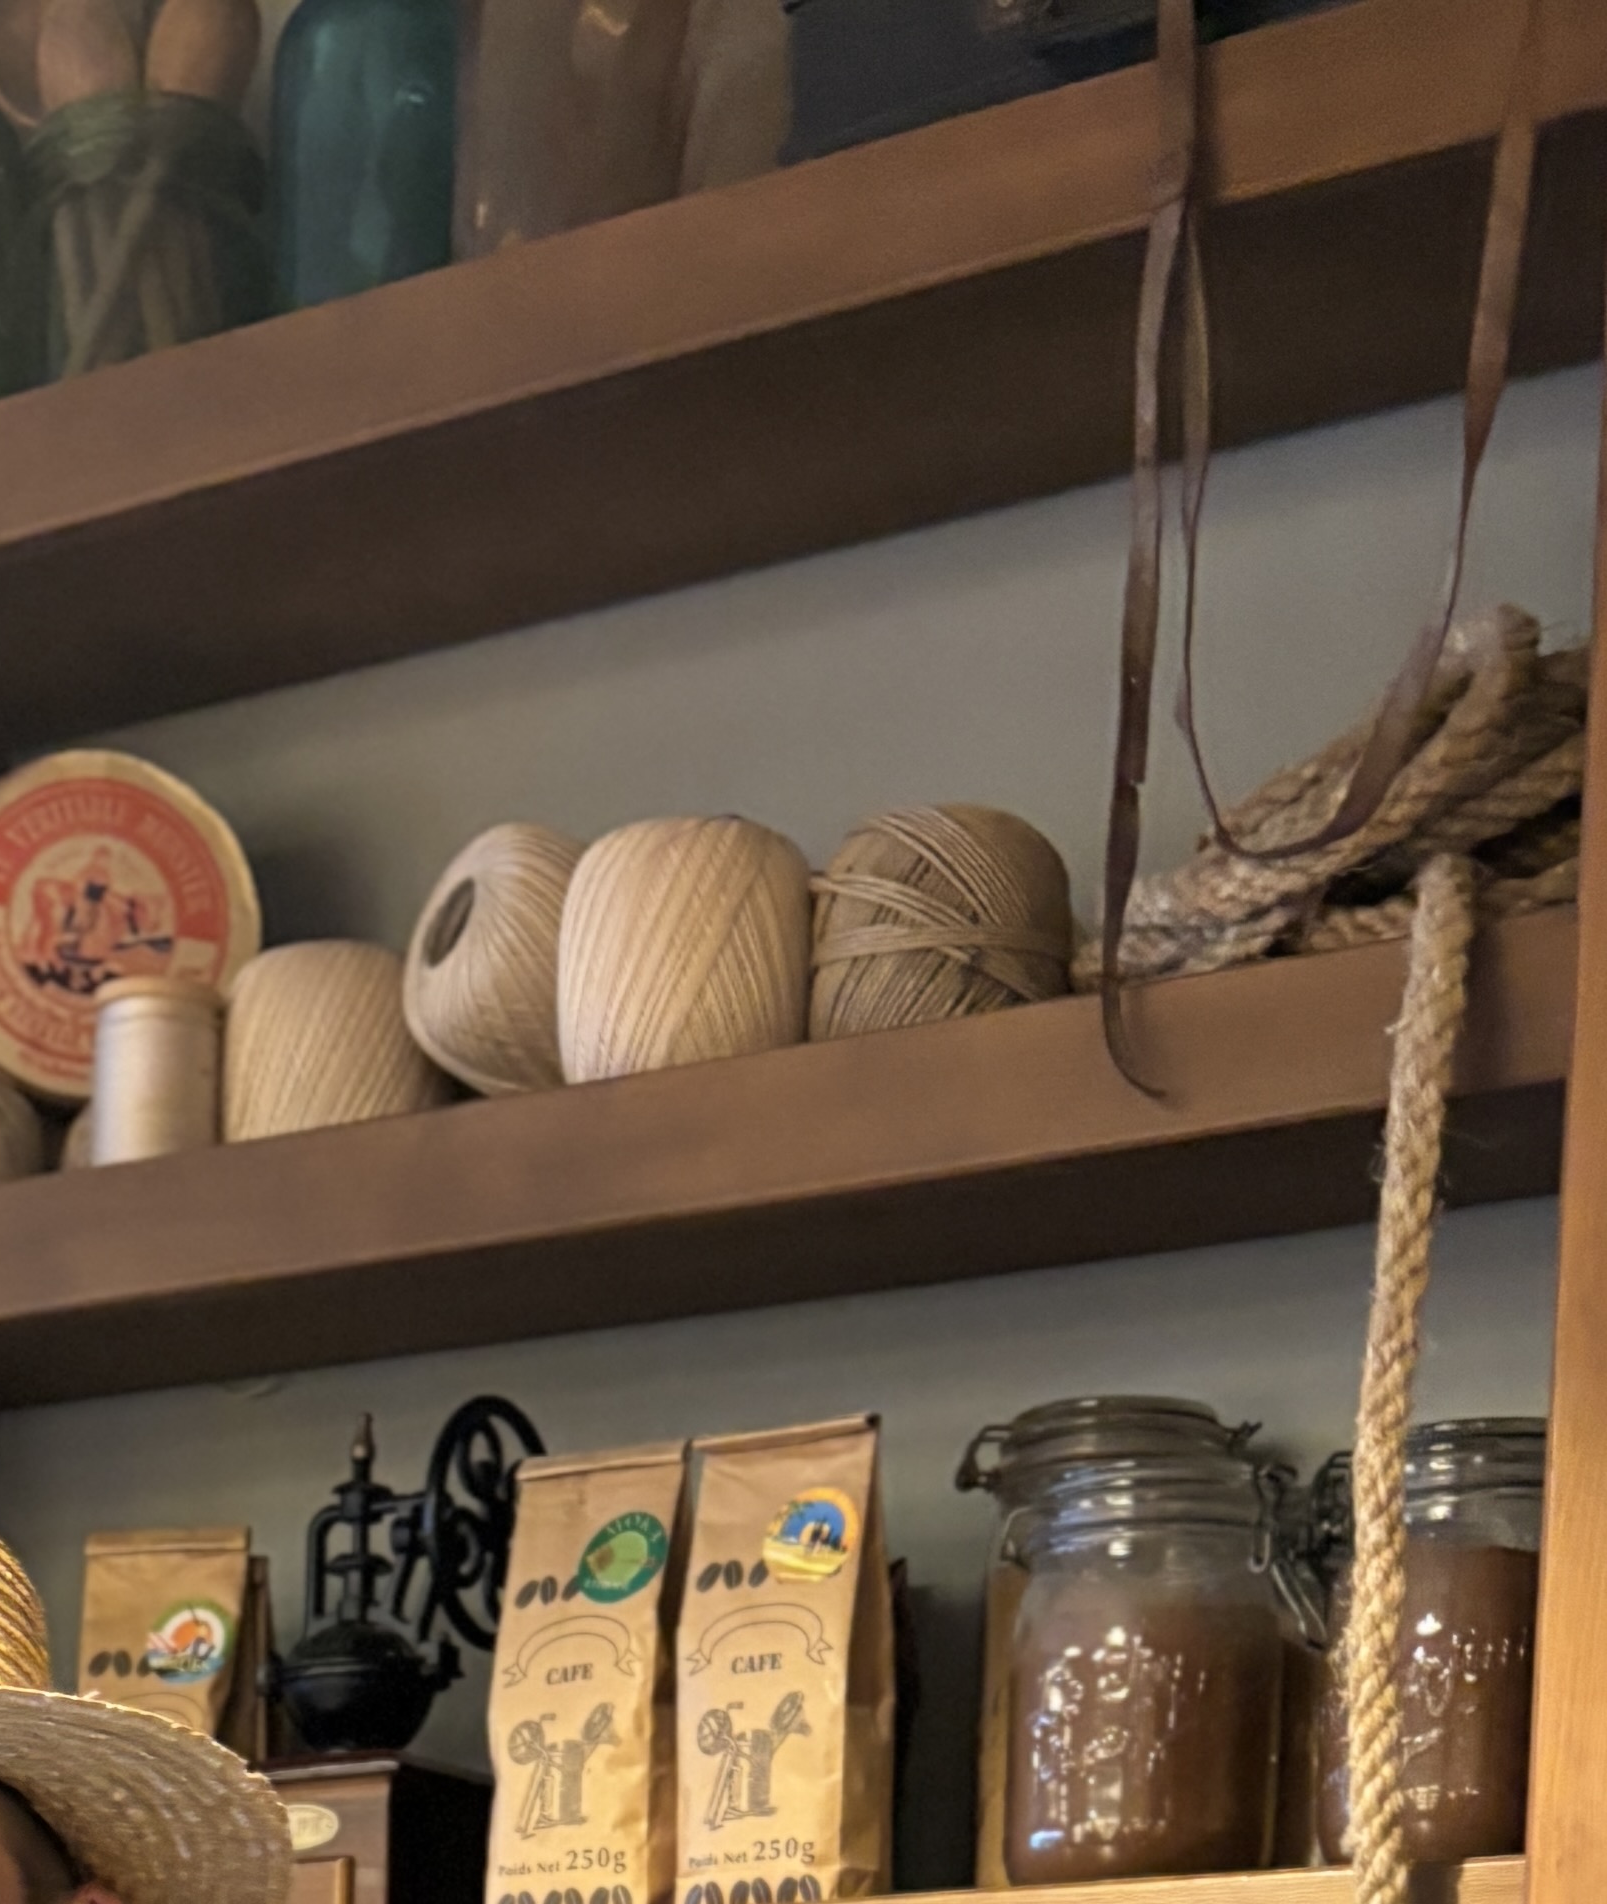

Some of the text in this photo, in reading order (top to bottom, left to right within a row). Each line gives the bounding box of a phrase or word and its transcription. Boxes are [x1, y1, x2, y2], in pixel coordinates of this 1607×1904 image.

[545, 1661, 594, 1686] CAFE
[731, 1651, 783, 1676] CAFE
[536, 1859, 561, 1875] Net
[565, 1846, 628, 1875] 250g
[723, 1850, 748, 1865] Net
[753, 1837, 817, 1864] 250g
